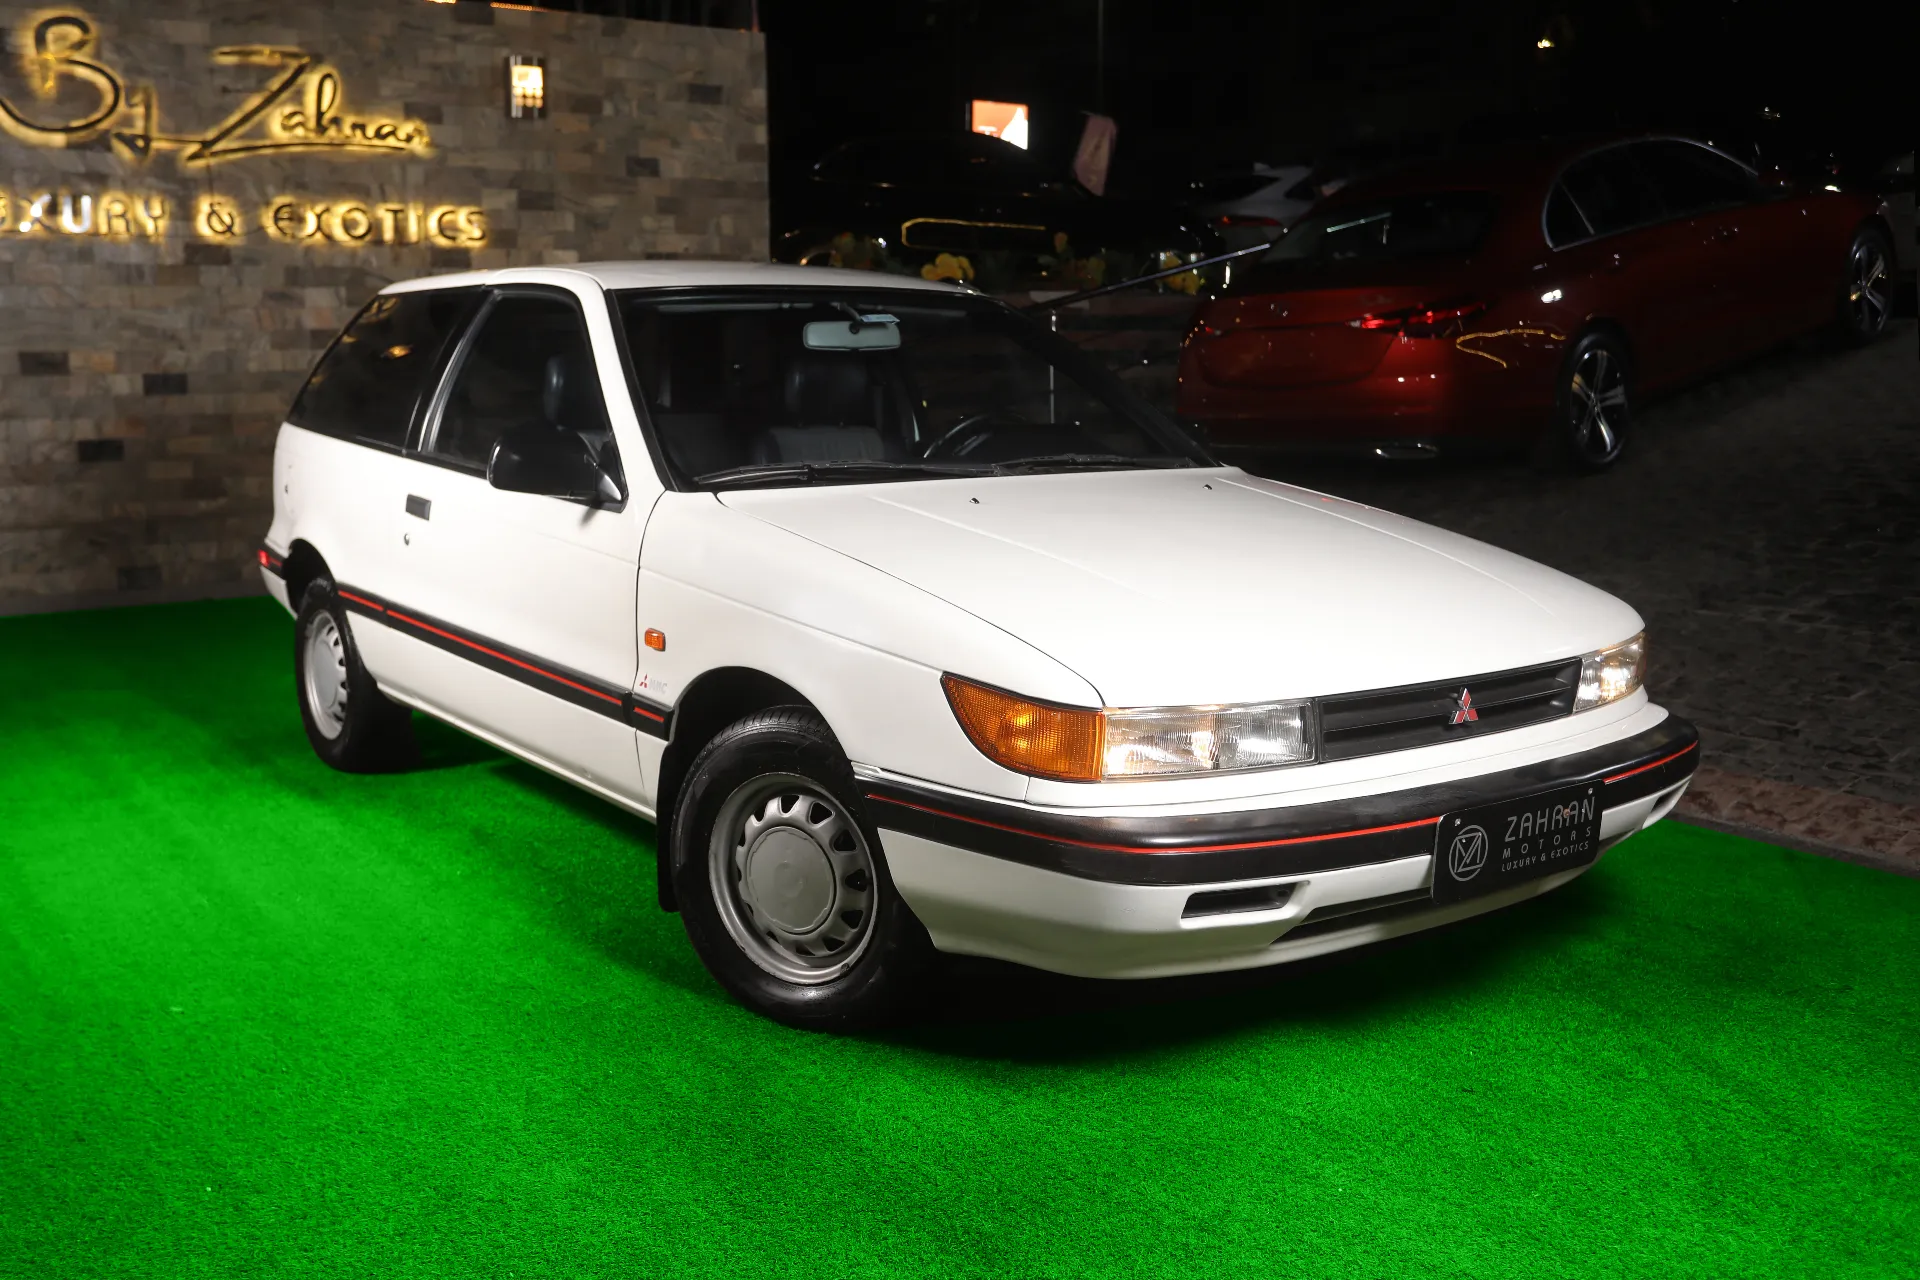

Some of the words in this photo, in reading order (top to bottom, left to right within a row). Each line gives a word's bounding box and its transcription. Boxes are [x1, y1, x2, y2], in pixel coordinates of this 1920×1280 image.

[187, 52, 430, 161] Zahran
[0, 194, 165, 235] XURY
[206, 201, 237, 237] &
[273, 202, 486, 242] EXOTICS
[1505, 796, 1595, 842] ZAHRAN
[1502, 826, 1592, 859] MOTORS
[1502, 856, 1537, 872] LUXURY
[1540, 853, 1547, 862] &
[1551, 841, 1589, 859] EXOTICS
